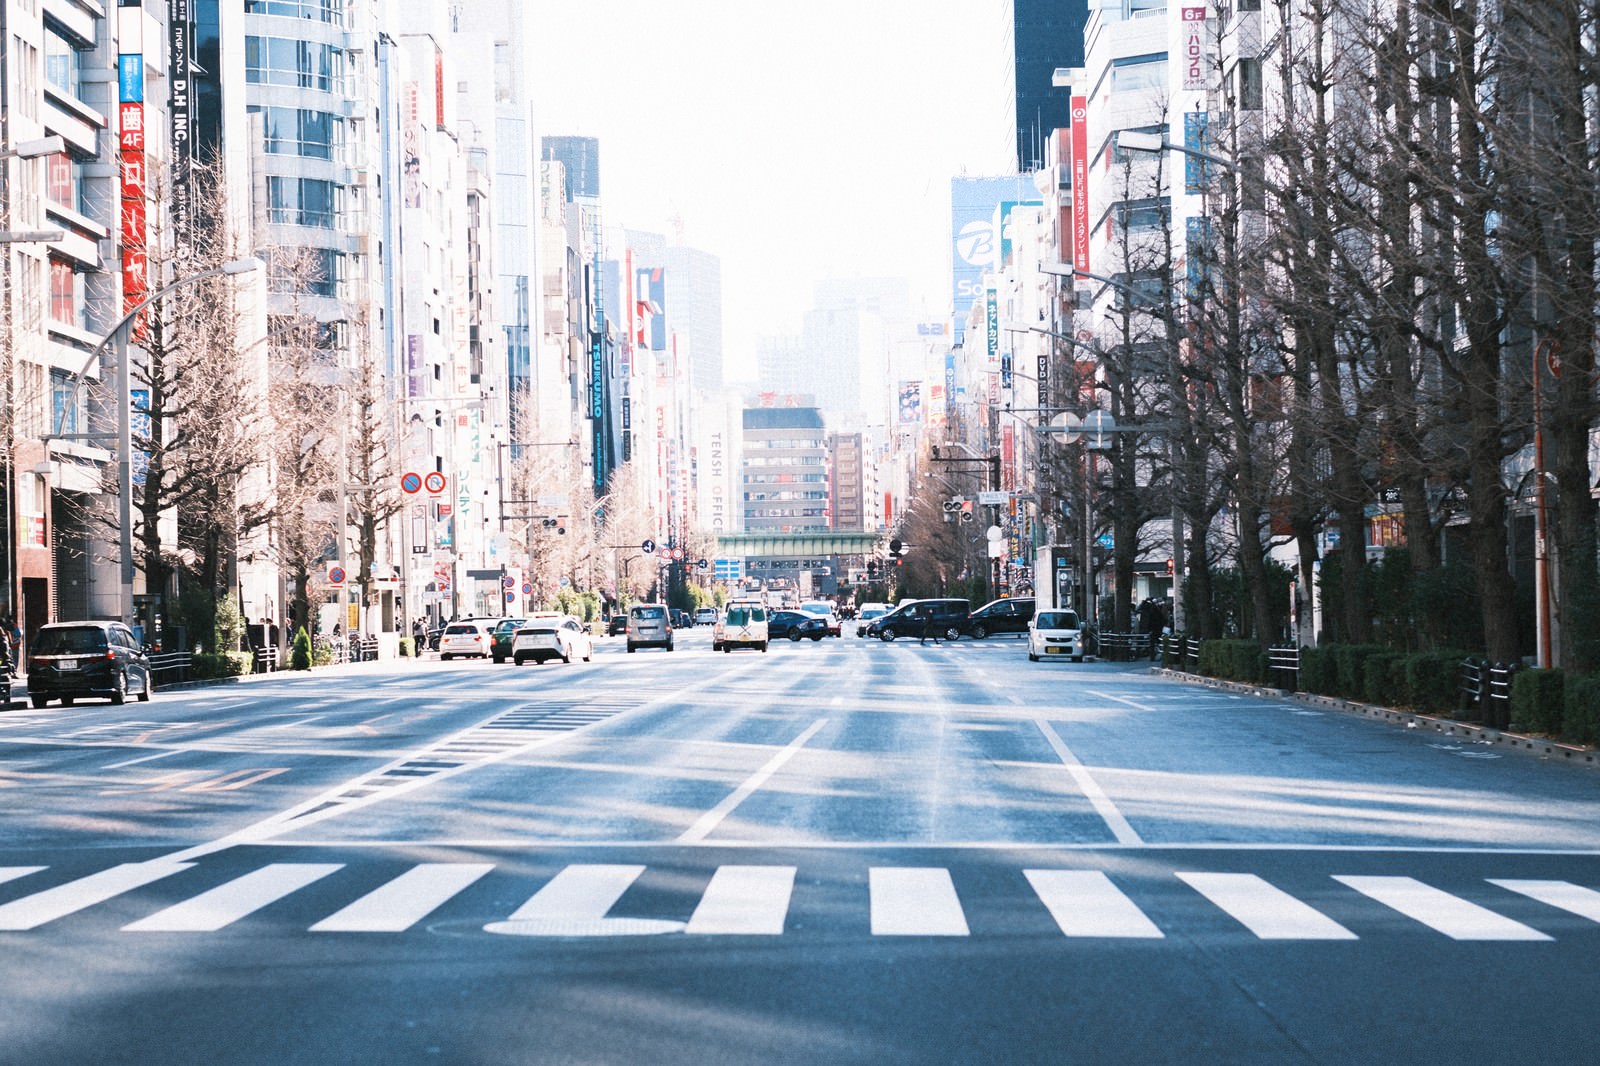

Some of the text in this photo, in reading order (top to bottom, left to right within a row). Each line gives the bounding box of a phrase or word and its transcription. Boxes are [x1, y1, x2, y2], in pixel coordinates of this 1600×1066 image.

[1185, 9, 1202, 19] 6F
[1188, 35, 1200, 77] ハロプロ
[122, 107, 141, 131] 歯
[122, 133, 142, 147] 4F
[988, 305, 997, 352] ネットカフェ
[593, 343, 602, 418] TSUKUMO
